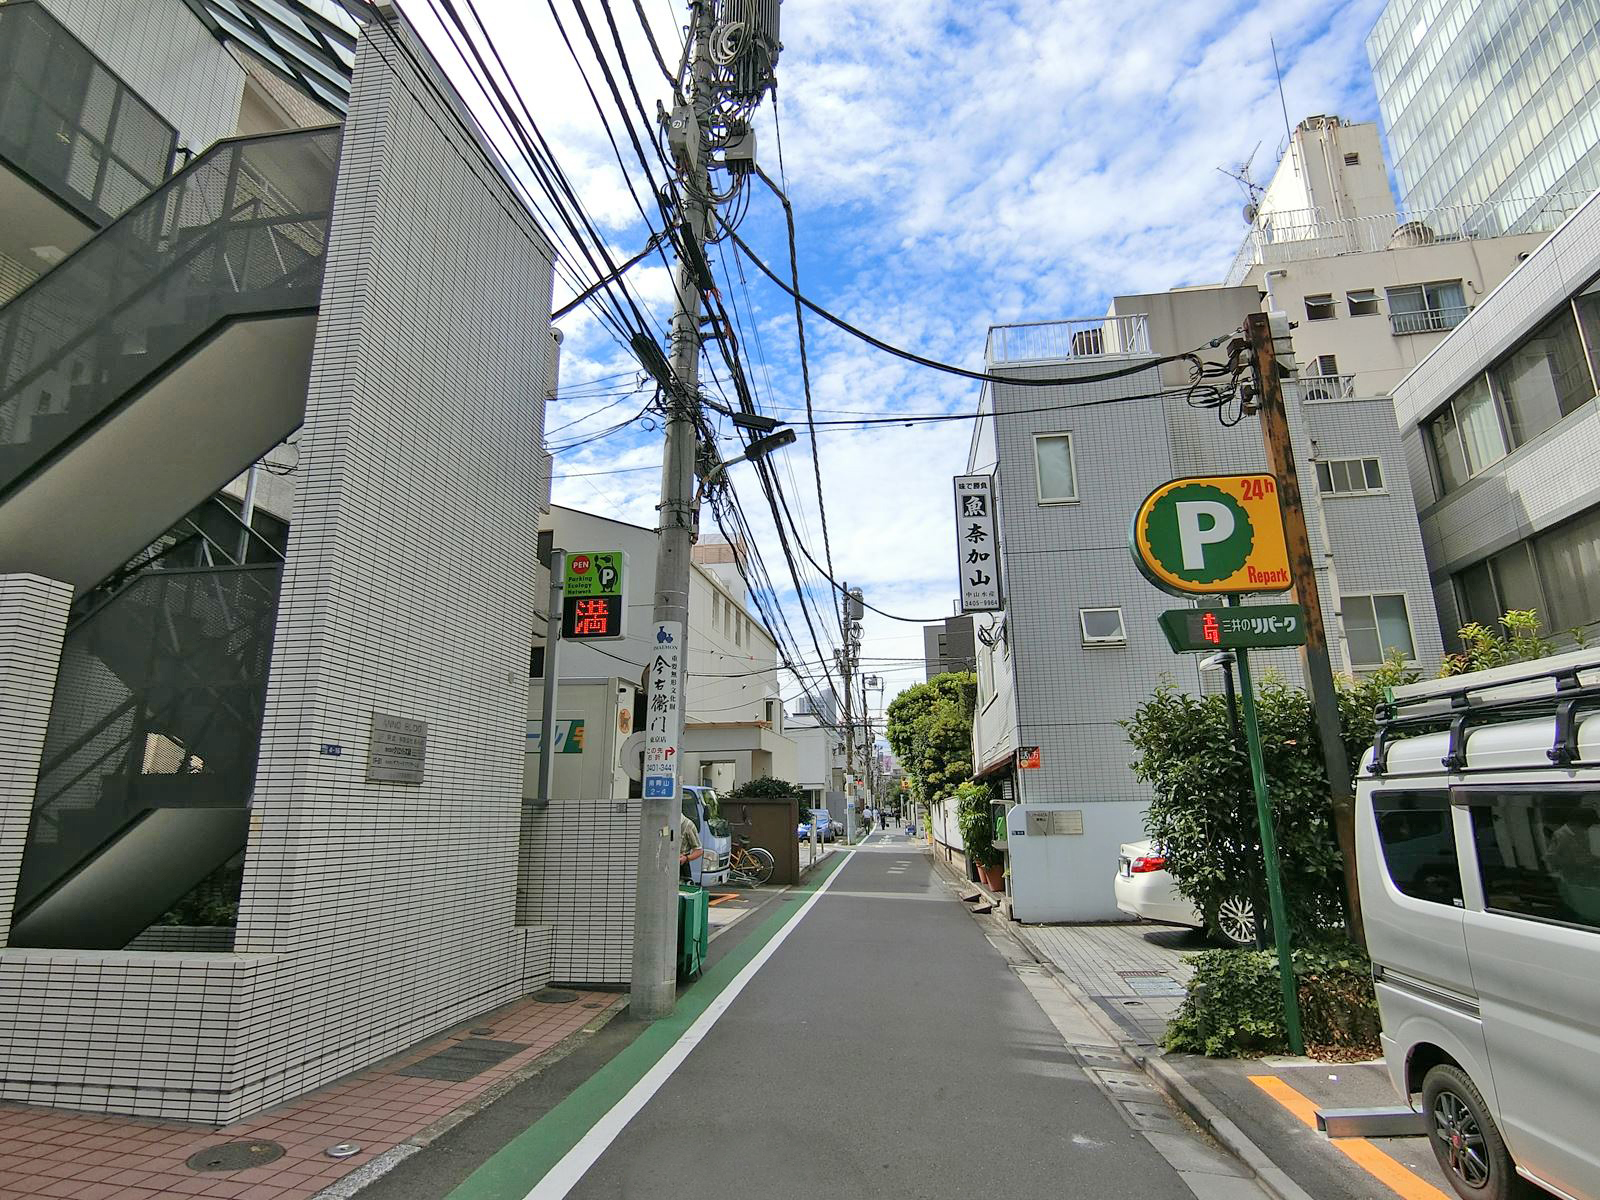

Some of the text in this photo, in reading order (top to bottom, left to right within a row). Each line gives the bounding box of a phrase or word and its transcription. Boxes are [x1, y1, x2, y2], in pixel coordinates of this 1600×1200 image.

[958, 482, 988, 490] 味で勝負
[1240, 479, 1274, 501] 24h
[1175, 500, 1236, 571] P
[572, 560, 589, 569] PEN
[601, 568, 614, 585] P
[1247, 565, 1289, 586] Repark
[575, 599, 609, 634] 満
[1222, 616, 1297, 635] 三井のリパーク
[650, 788, 667, 796] 2-4
